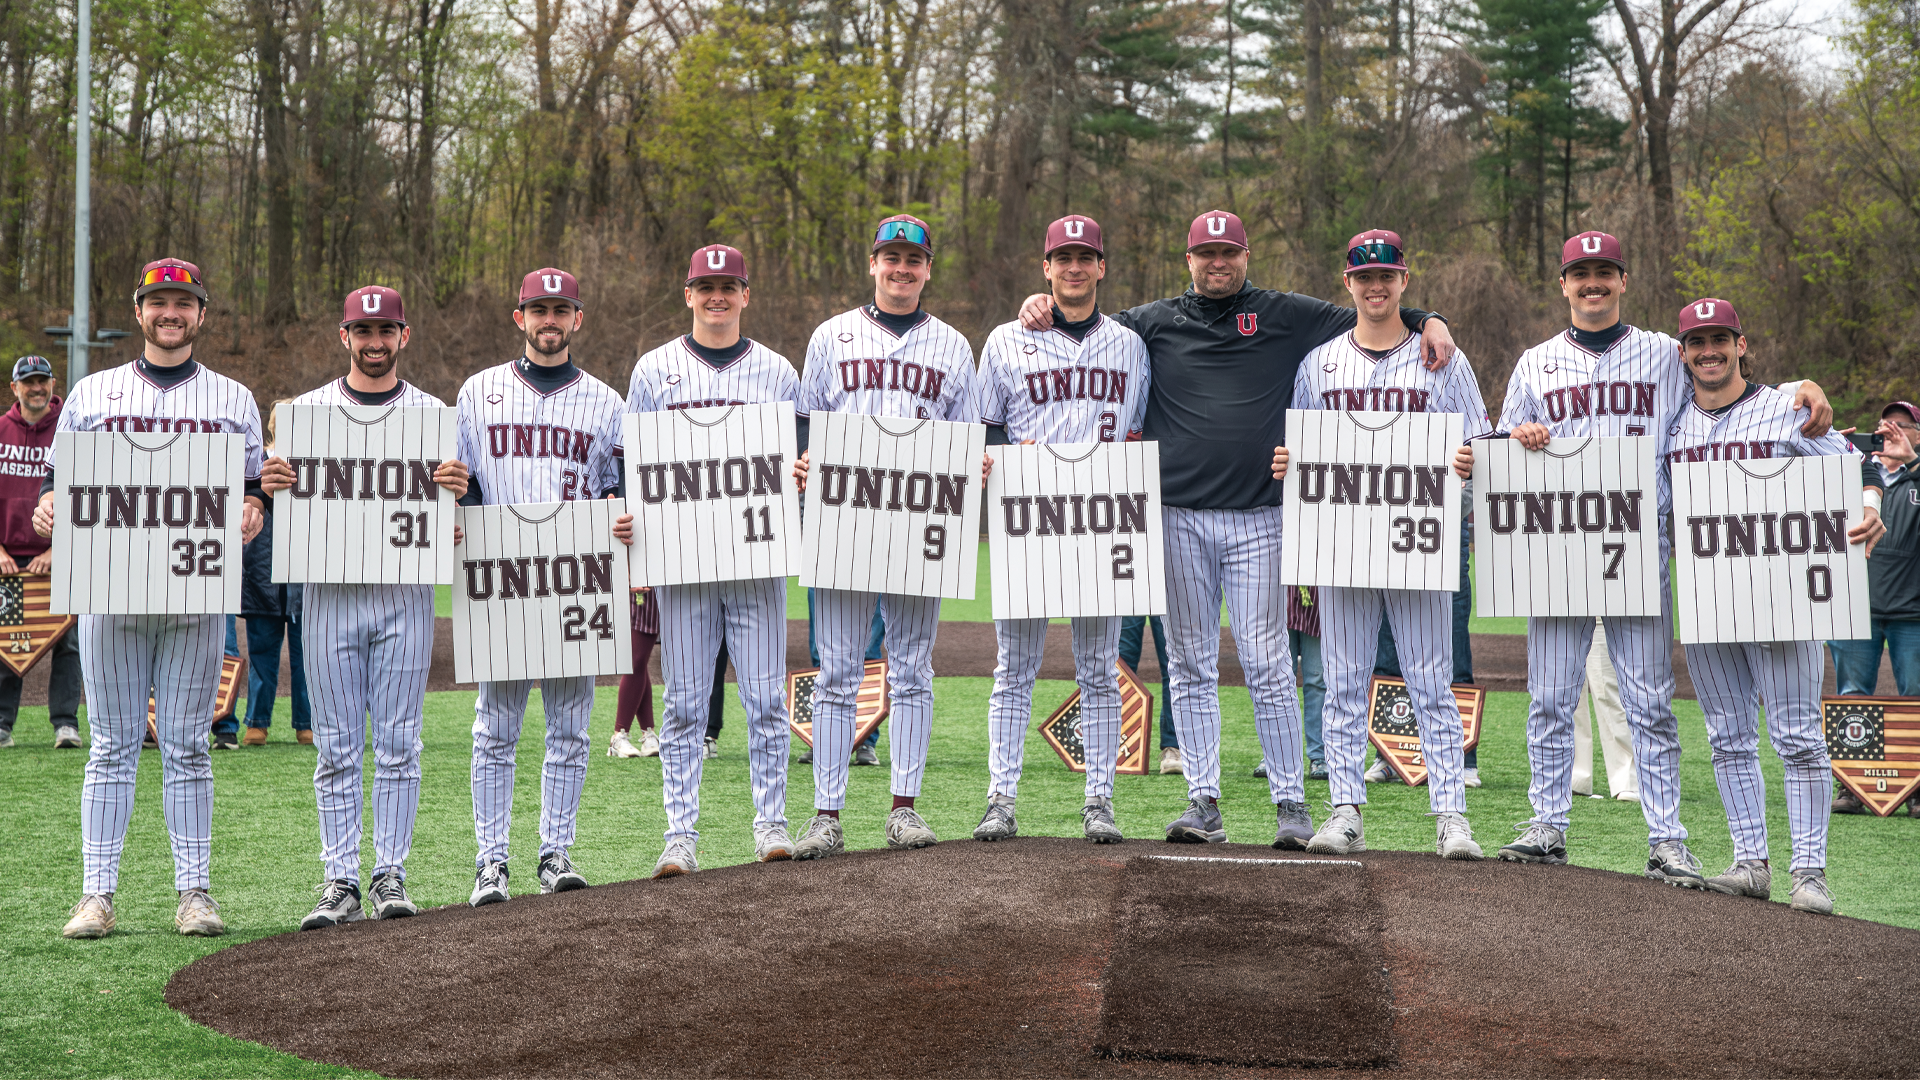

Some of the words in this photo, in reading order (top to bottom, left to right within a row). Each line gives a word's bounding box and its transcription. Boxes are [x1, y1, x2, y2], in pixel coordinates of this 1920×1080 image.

[1064, 220, 1085, 239] U
[1207, 217, 1227, 237] U
[1580, 236, 1602, 255] U
[706, 250, 727, 270] U
[541, 274, 562, 294] U
[361, 293, 382, 314] U
[1693, 301, 1716, 321] U
[1236, 313, 1258, 336] U
[838, 357, 947, 402] UNION
[1024, 366, 1128, 405] UNION
[1543, 380, 1657, 422] UNION
[487, 423, 596, 465] UNION
[1099, 410, 1117, 442] 2
[287, 457, 442, 501] UNION
[637, 453, 784, 505] UNION
[819, 463, 969, 516] UNION
[1297, 462, 1448, 508] UNION
[68, 485, 230, 529] UNION
[742, 505, 775, 543] 11
[1000, 492, 1148, 537] UNION
[1486, 489, 1642, 535] UNION
[390, 511, 430, 548] 31
[923, 524, 947, 561] 9
[1392, 516, 1441, 554] 39
[1687, 509, 1848, 559] UNION
[172, 538, 222, 577] 32
[463, 552, 614, 601] UNION
[1111, 543, 1135, 580] 2
[1602, 542, 1626, 580] 7
[1806, 564, 1833, 603] 0
[562, 603, 614, 642] 24
[11, 640, 31, 653] 24
[1396, 705, 1408, 717] U
[1849, 725, 1862, 739] U
[1863, 769, 1899, 777] MILLER
